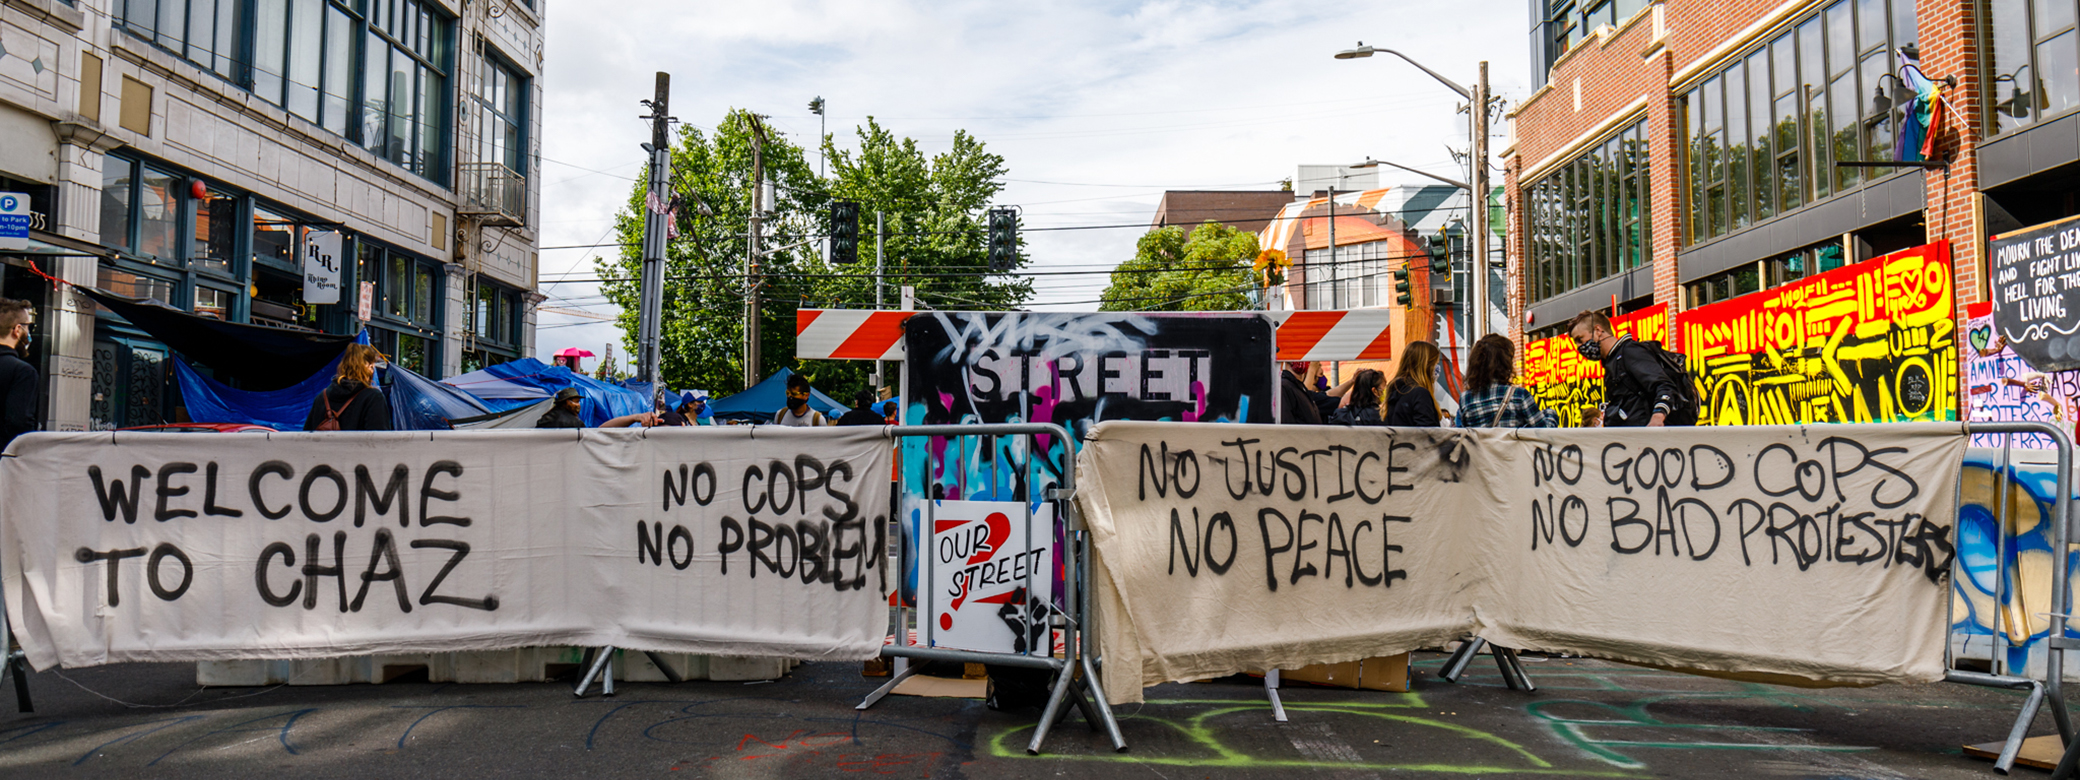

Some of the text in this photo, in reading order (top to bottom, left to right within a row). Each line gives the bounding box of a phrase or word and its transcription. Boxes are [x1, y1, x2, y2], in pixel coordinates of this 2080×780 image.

[1508, 212, 1517, 318] STOUT
[1997, 242, 2030, 268] MOURN
[2035, 235, 2054, 257] THE
[1998, 267, 2017, 285] AND
[2029, 255, 2061, 278] FIGHT
[307, 273, 328, 284] Rhino
[317, 281, 338, 290] Room
[2005, 282, 2029, 304] HELL
[2035, 276, 2057, 297] FOR
[2020, 293, 2066, 322] LIVING
[969, 349, 1210, 400] STREET
[2050, 370, 2080, 399] AB
[1974, 433, 2042, 449] RIOERS
[663, 454, 860, 522] NO COPS
[1138, 437, 1416, 505] NO JUSTICE
[1534, 443, 1584, 488] NO
[1601, 442, 1736, 494] GOOD
[88, 460, 472, 527] WELCOME
[637, 514, 888, 600] NO PROBLEM
[940, 524, 992, 564] OUR
[1168, 506, 1412, 592] NO PEACE
[1531, 486, 1956, 584] NO BAD PROTESTERS
[75, 528, 499, 613] TO CHAZ
[948, 547, 1047, 597] STREET
